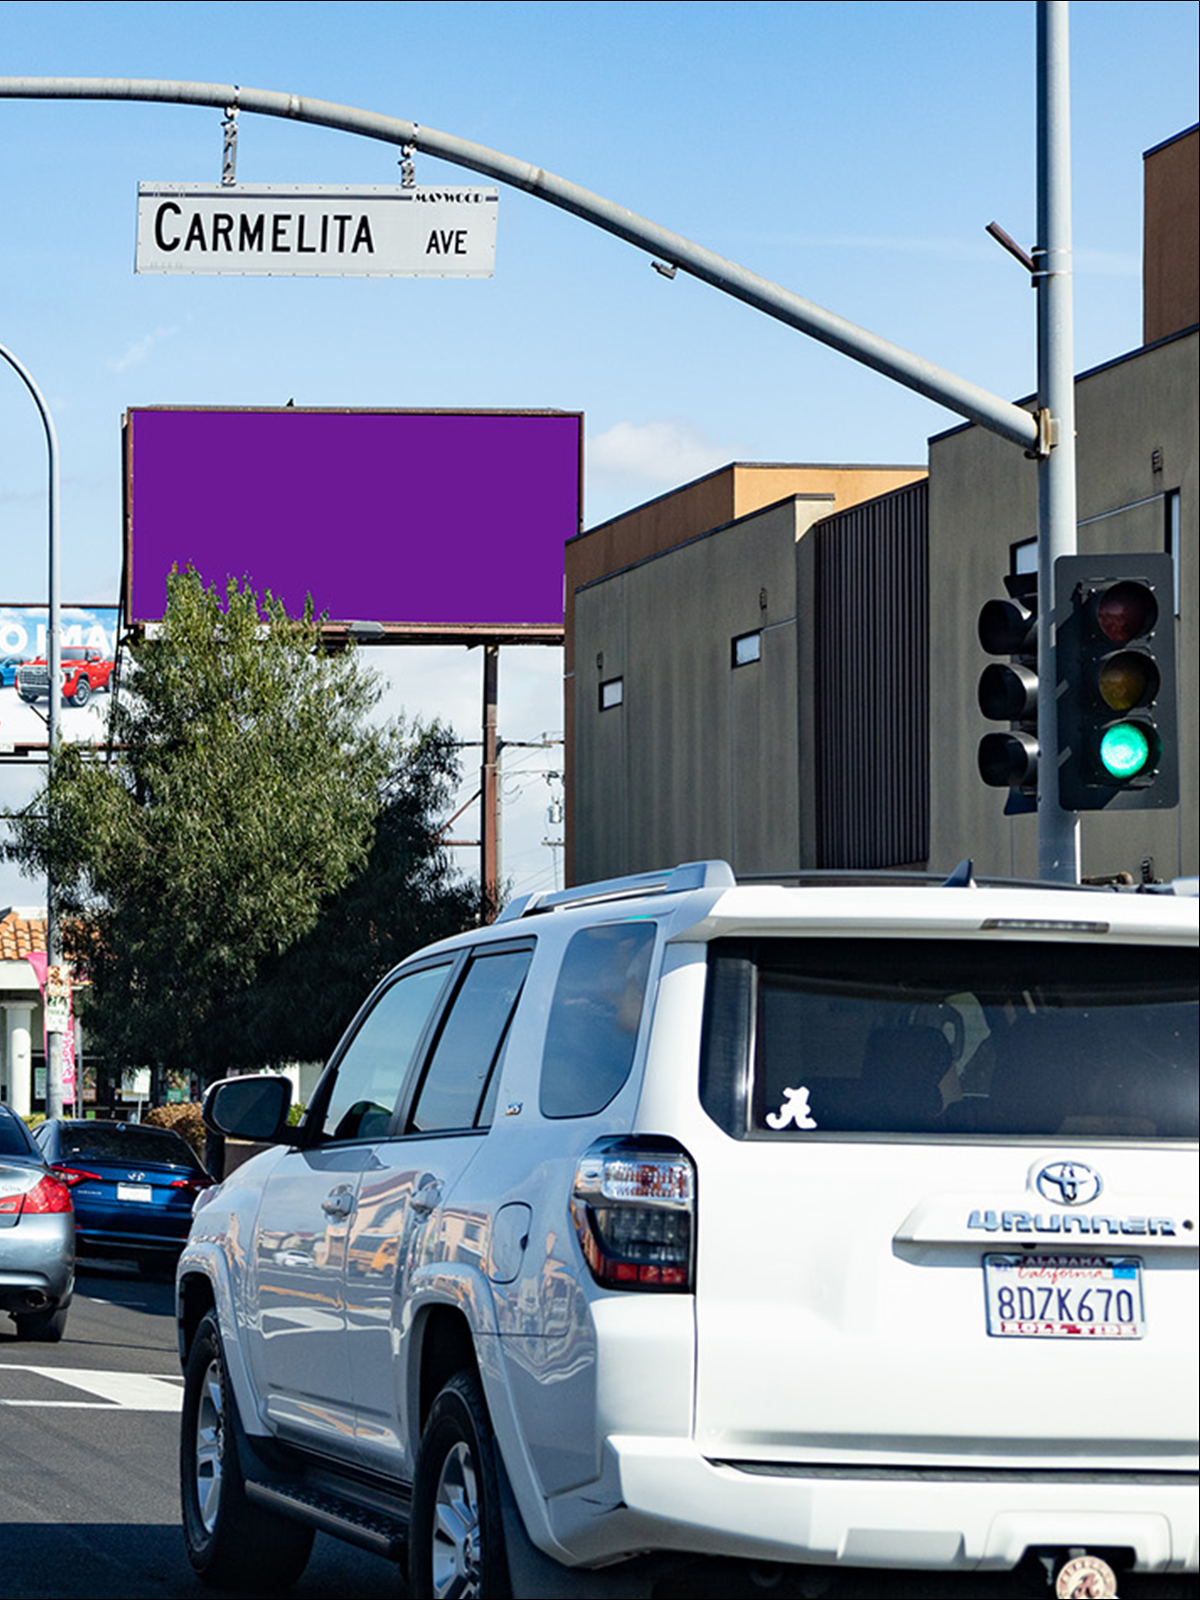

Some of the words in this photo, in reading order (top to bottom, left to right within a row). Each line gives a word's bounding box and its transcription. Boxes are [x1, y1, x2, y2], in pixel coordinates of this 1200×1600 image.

[415, 192, 484, 203] MAYWOOD
[154, 201, 375, 253] CARMELITA
[426, 230, 468, 255] AVE
[36, 624, 118, 656] IMA
[967, 1210, 1176, 1236] 4RUNNER
[1024, 1256, 1104, 1267] ALABAMA
[1017, 1266, 1103, 1285] California
[997, 1286, 1134, 1323] 8DZK670
[1003, 1322, 1068, 1334] ROLL
[1079, 1323, 1136, 1335] TIDE
